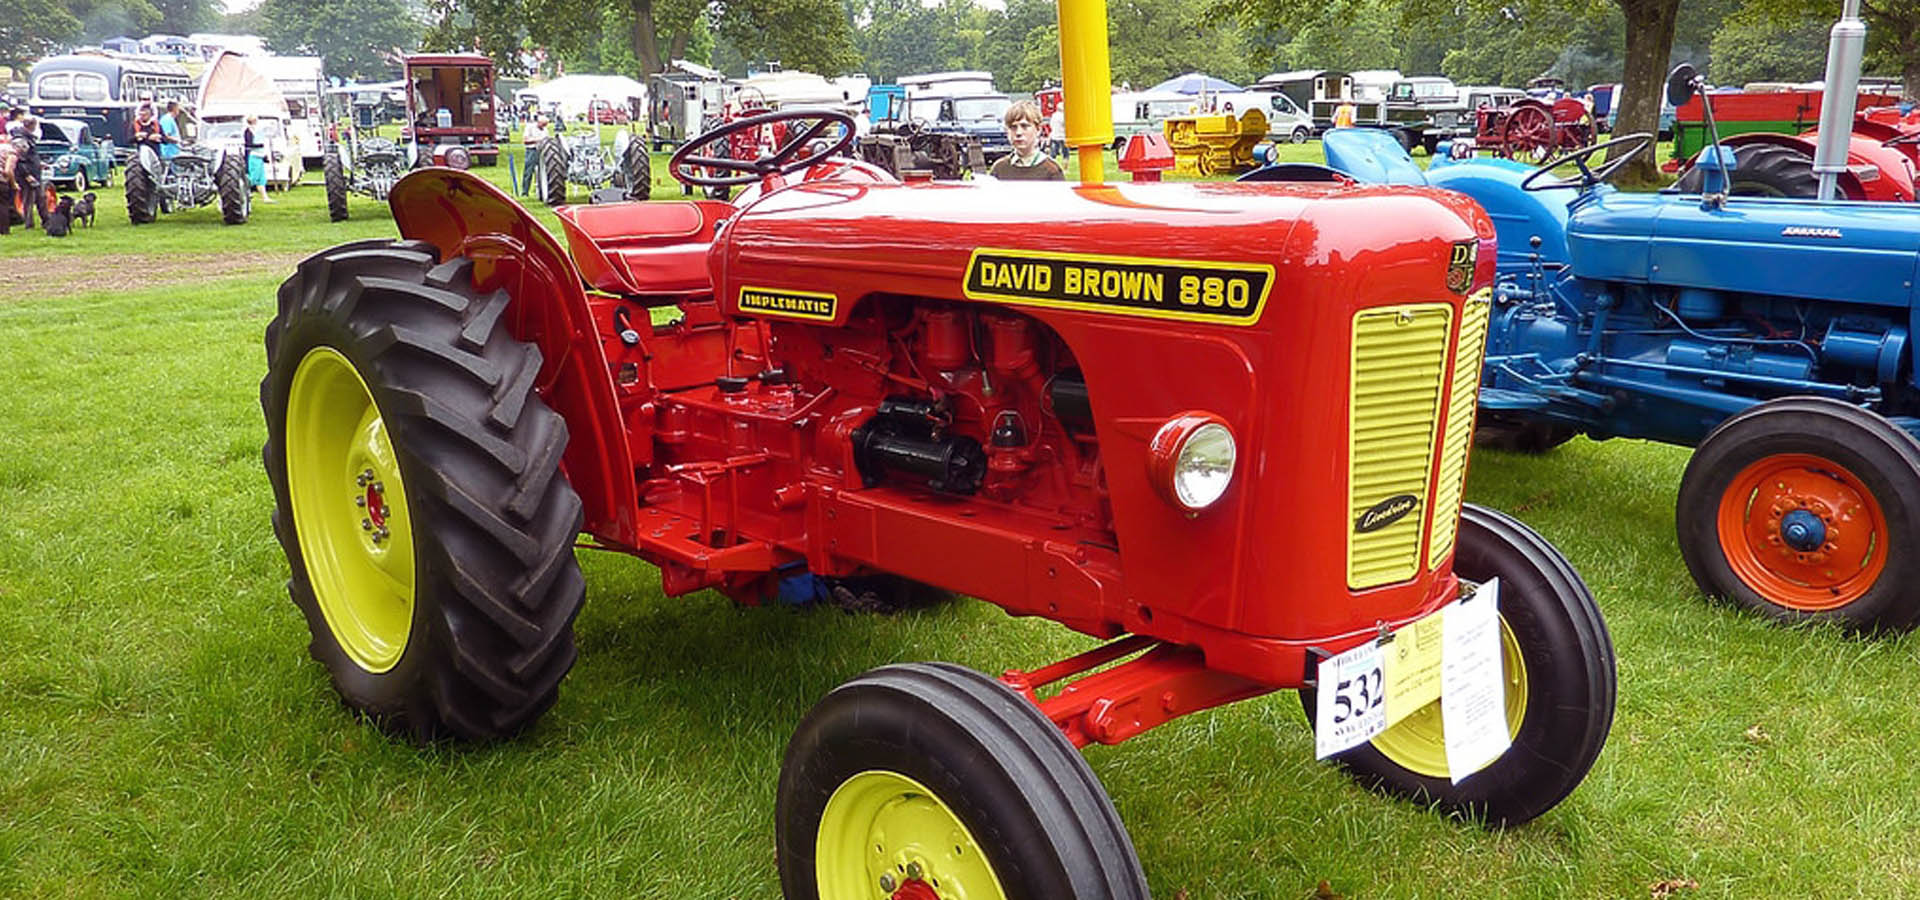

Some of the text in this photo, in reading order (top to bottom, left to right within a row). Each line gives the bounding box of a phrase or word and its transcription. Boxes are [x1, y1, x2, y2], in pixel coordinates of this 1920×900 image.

[744, 293, 830, 313] IMPLEMATIC
[981, 262, 1249, 309] DAVID BROWN 880
[1333, 667, 1384, 724] 532
